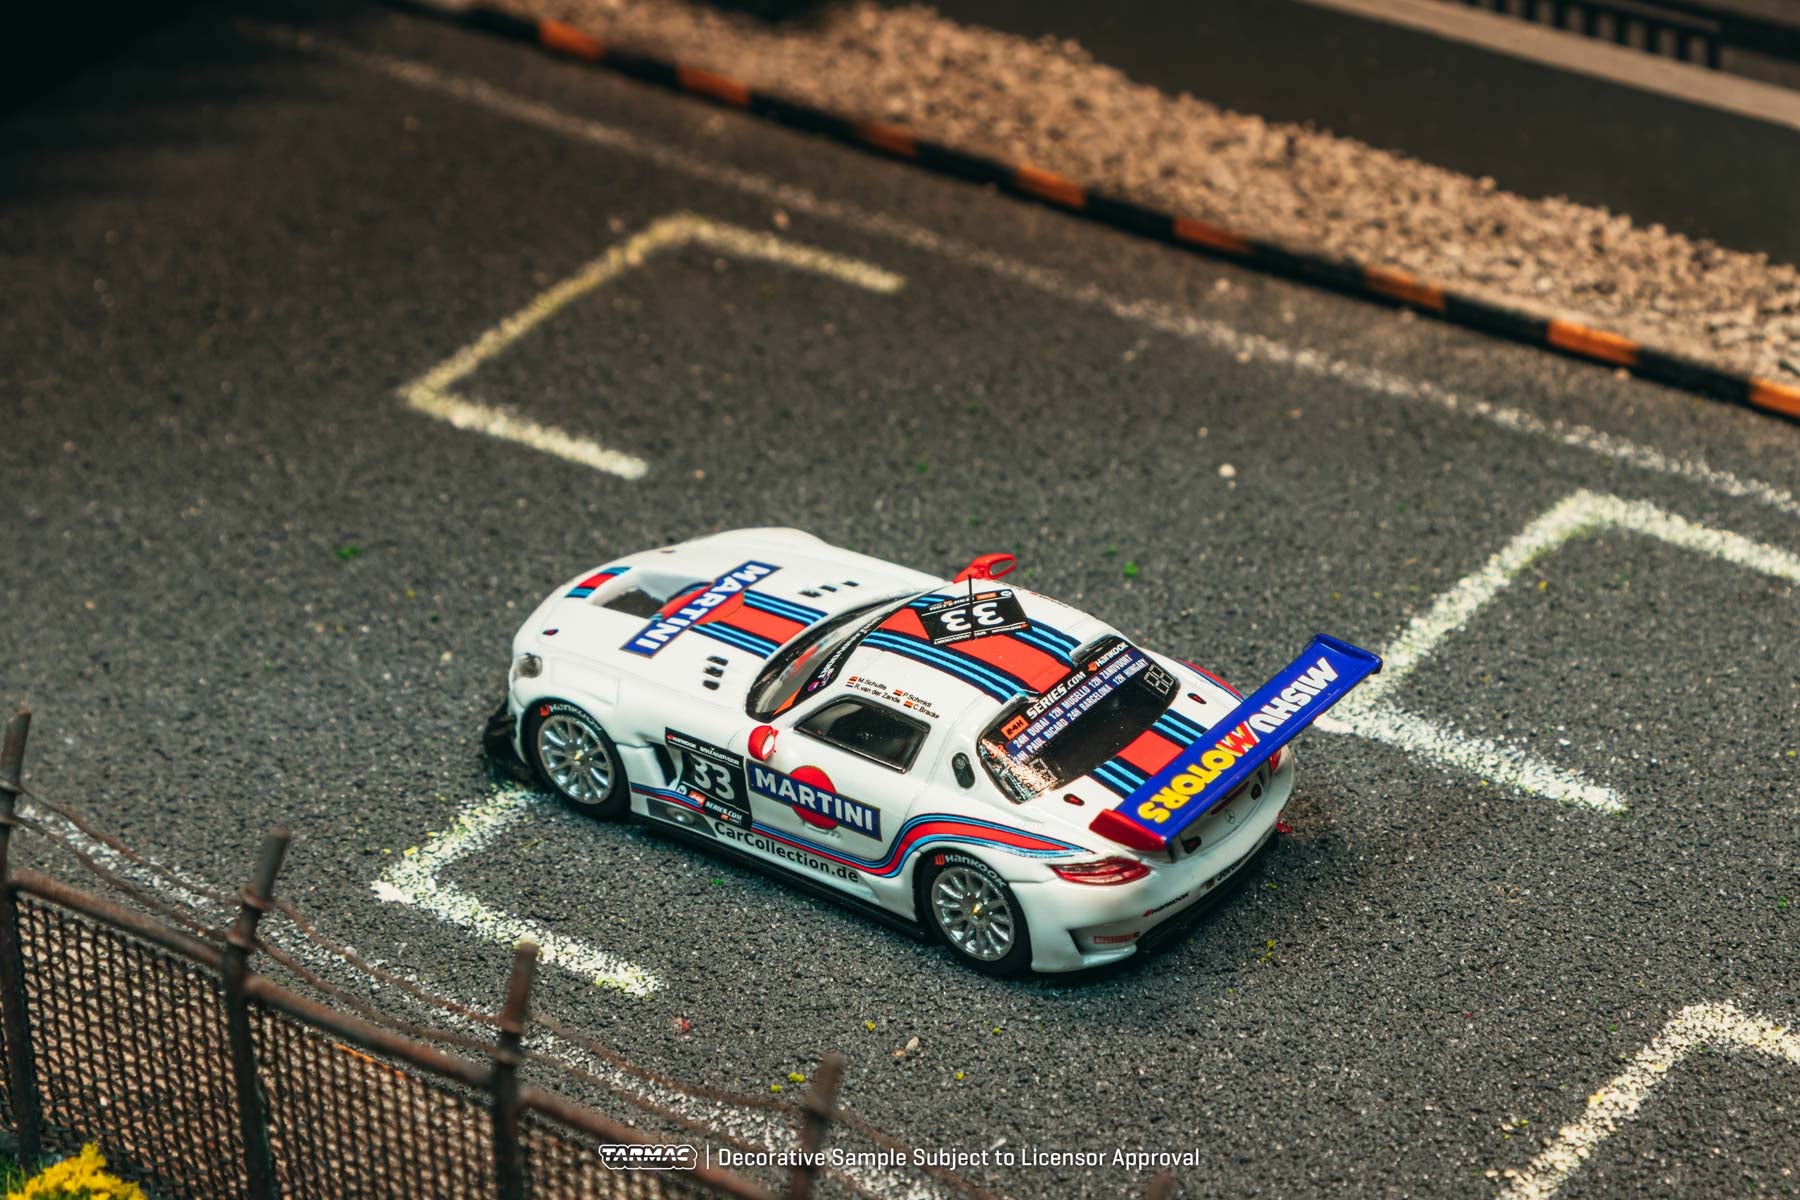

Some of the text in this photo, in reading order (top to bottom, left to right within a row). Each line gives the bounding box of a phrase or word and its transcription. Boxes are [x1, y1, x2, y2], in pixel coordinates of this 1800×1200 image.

[634, 564, 771, 650] MARTINI
[940, 602, 1005, 632] 33
[1006, 719, 1024, 736] 24H
[1013, 653, 1133, 749] 24H DUBAI 12H MUGELLO 12H ZANDVOORT
[1025, 736, 1047, 754] PAUL
[1043, 718, 1069, 740] RICARD
[1066, 707, 1082, 721] 24H
[1079, 683, 1114, 712] BARCELONA
[1112, 673, 1127, 686] 12H
[690, 754, 735, 800] 33
[754, 767, 873, 831] MARTINI
[714, 820, 860, 884] CarCollection.de
